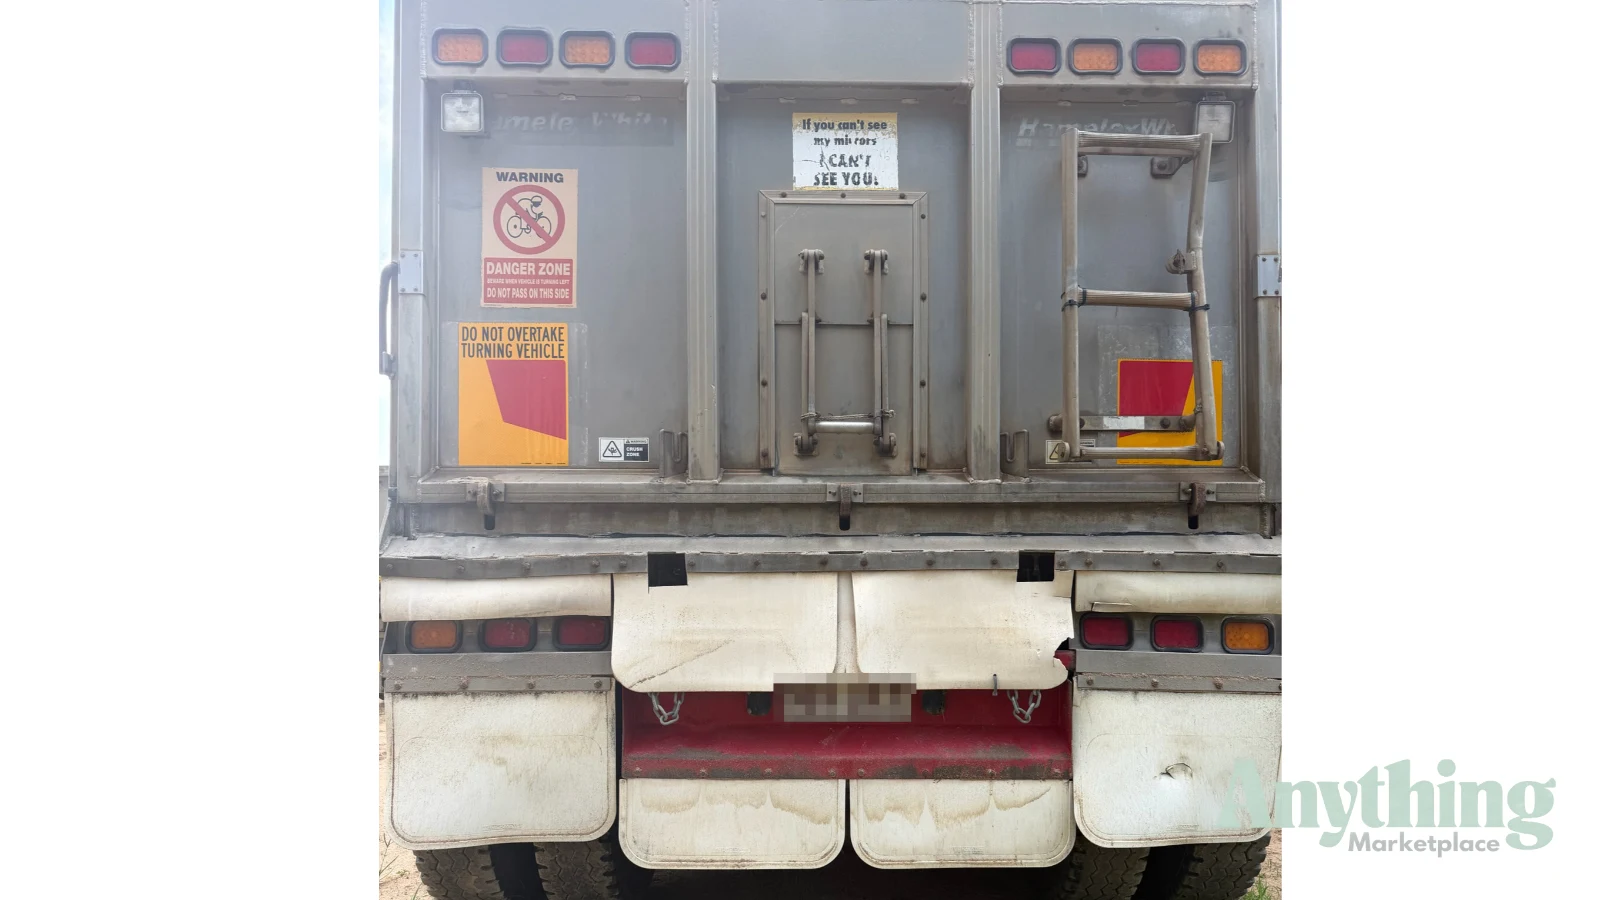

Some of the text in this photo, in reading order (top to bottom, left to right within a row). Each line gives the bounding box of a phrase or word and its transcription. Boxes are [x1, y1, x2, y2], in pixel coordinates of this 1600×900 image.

[802, 118, 888, 132] If you can't see
[813, 137, 830, 147] my
[828, 153, 871, 168] CAN'T
[496, 171, 564, 183] WARNING
[813, 172, 837, 186] SEE
[486, 261, 571, 276] DANGER ZONE
[487, 287, 570, 299] DO NOT PASS ON THIS SIDE
[462, 326, 565, 342] DO NOT OVERTAKE
[461, 343, 565, 359] TURNING VEHICLE
